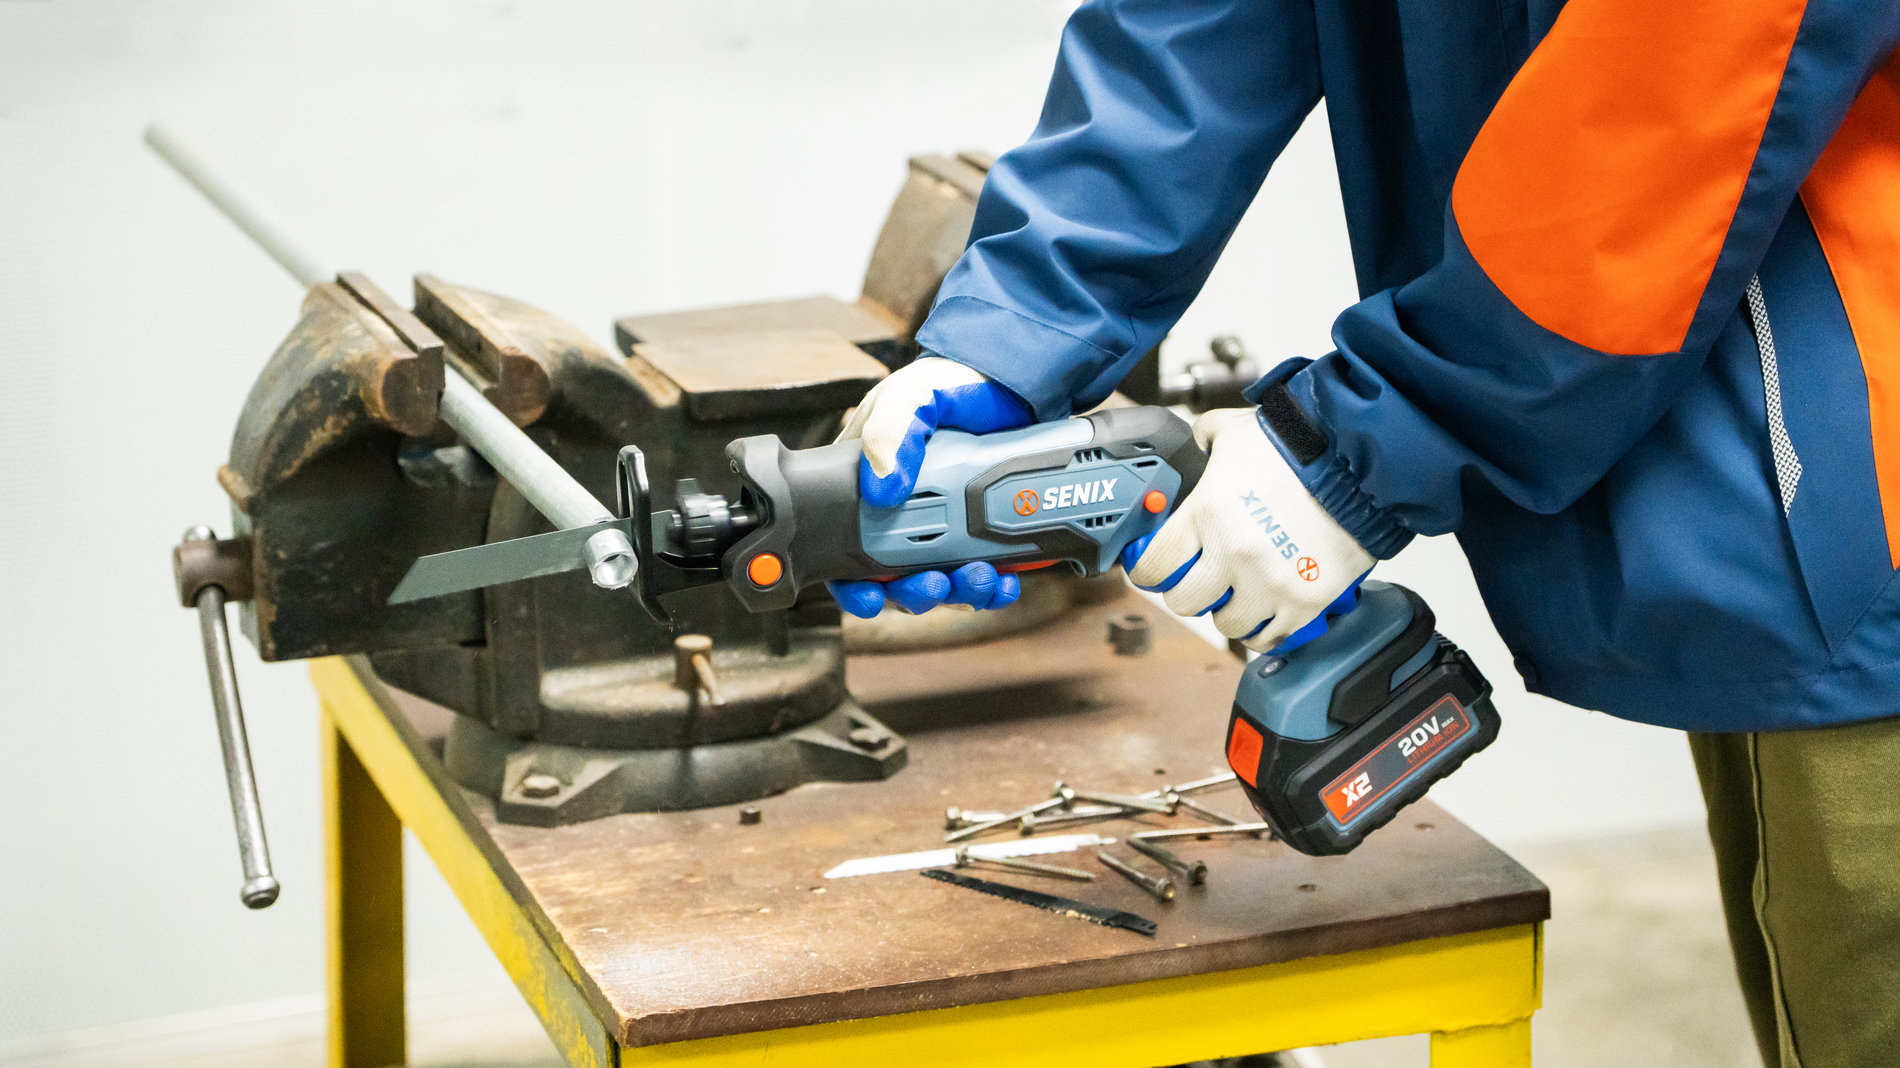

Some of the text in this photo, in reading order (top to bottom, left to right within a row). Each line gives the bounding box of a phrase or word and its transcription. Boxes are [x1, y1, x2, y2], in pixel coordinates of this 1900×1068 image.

[1042, 478, 1118, 511] SENIX
[1239, 489, 1300, 560] SENIX
[1398, 715, 1455, 757] 20V MAX
[1407, 722, 1459, 763] LITHIUM ION
[1341, 771, 1373, 808] X2
